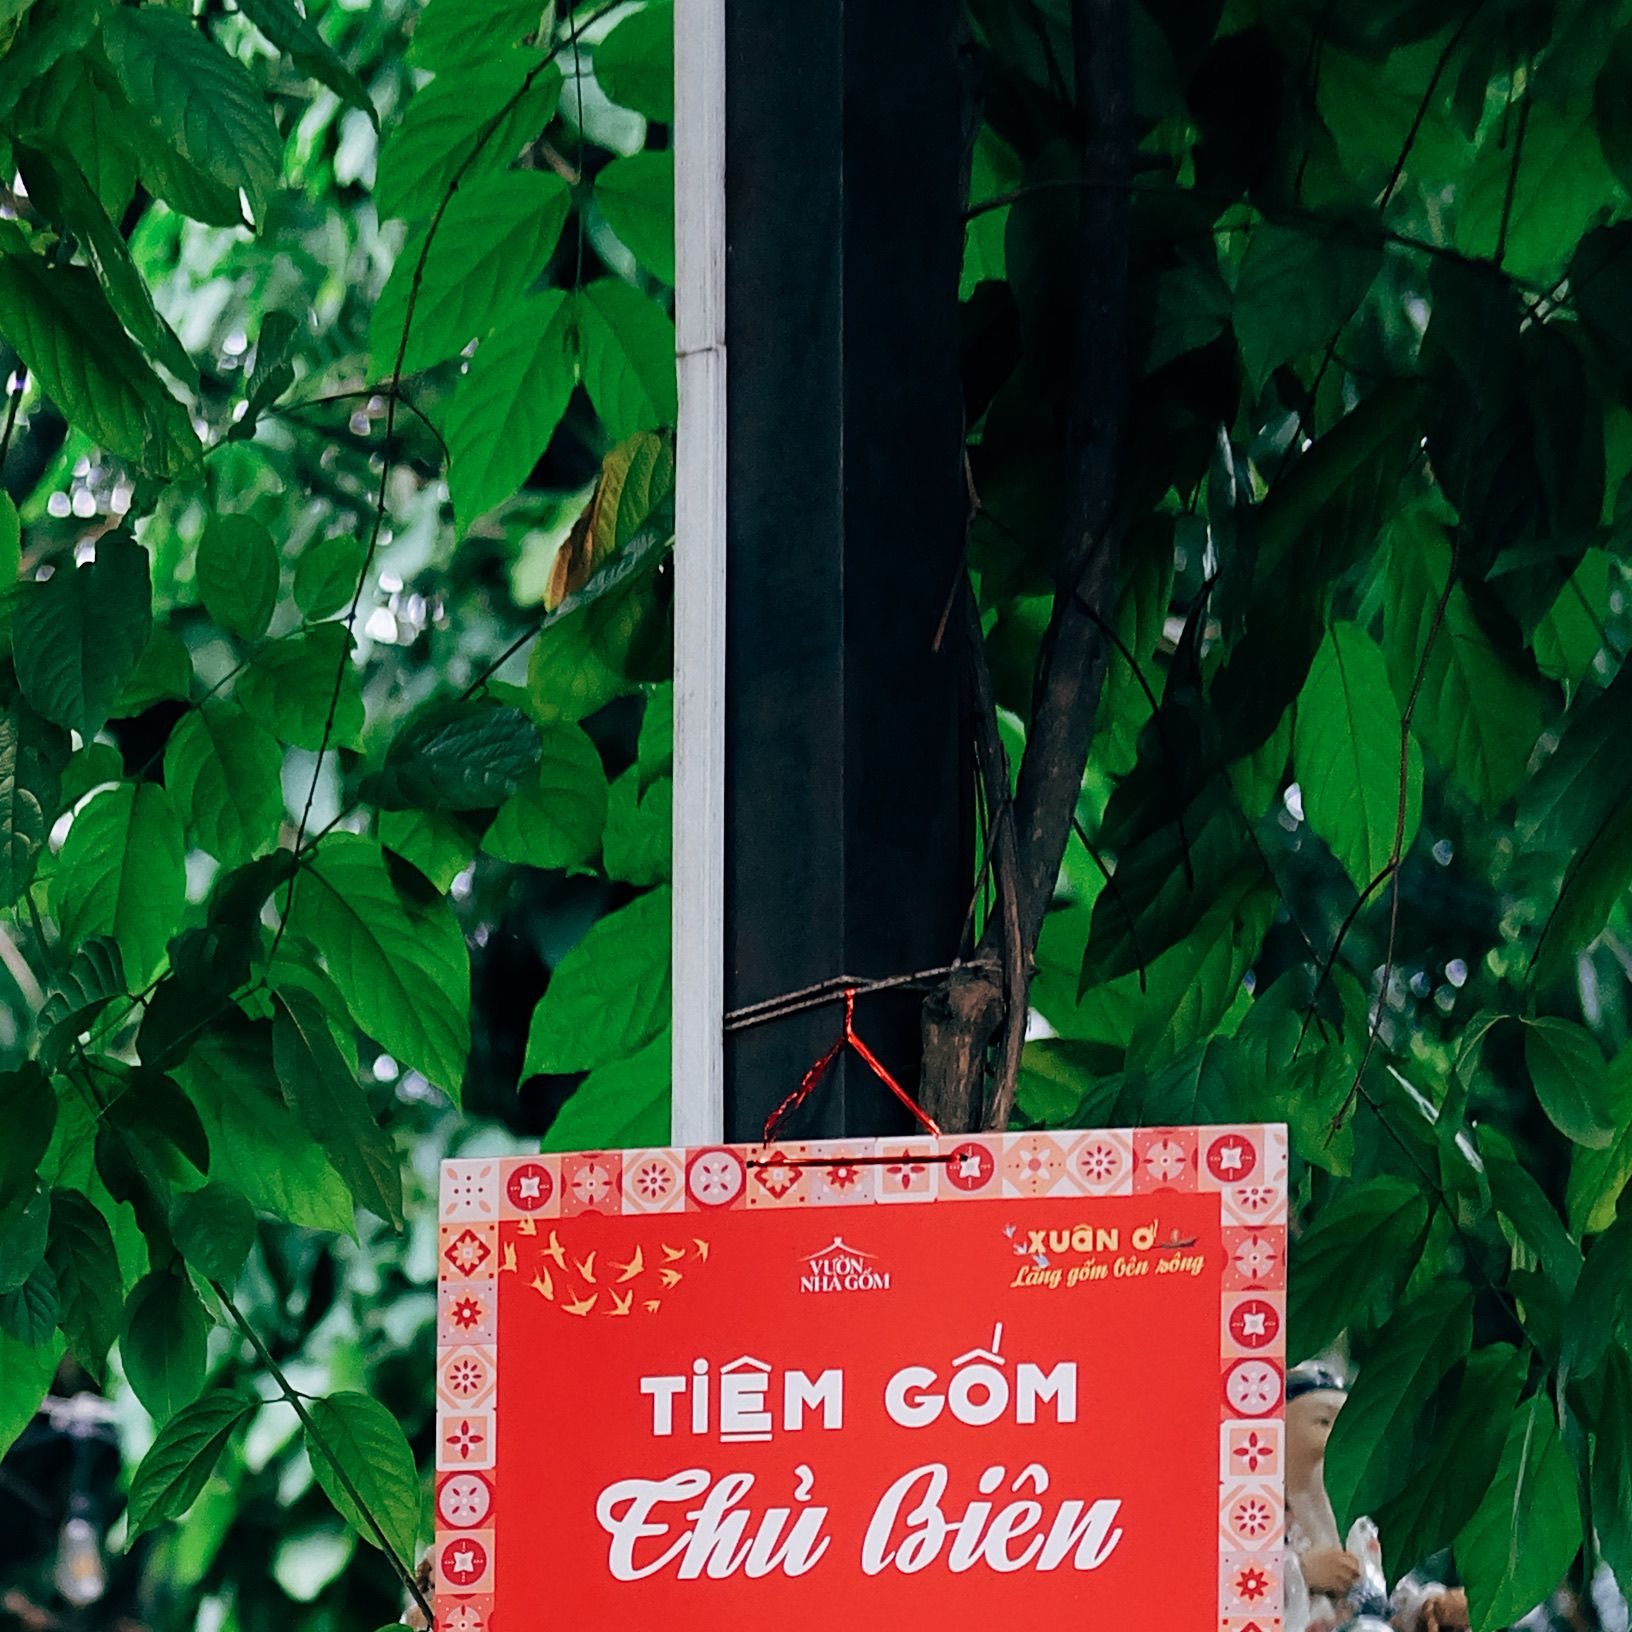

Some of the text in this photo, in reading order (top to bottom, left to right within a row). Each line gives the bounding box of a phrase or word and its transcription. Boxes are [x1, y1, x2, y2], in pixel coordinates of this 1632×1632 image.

[844, 1266, 890, 1291] GỐM
[1066, 1256, 1109, 1288] gốm
[1113, 1255, 1149, 1278] bên
[1154, 1250, 1205, 1277] sông
[883, 1321, 1078, 1430] GỐM
[595, 1462, 1124, 1582] Thủ Biên
